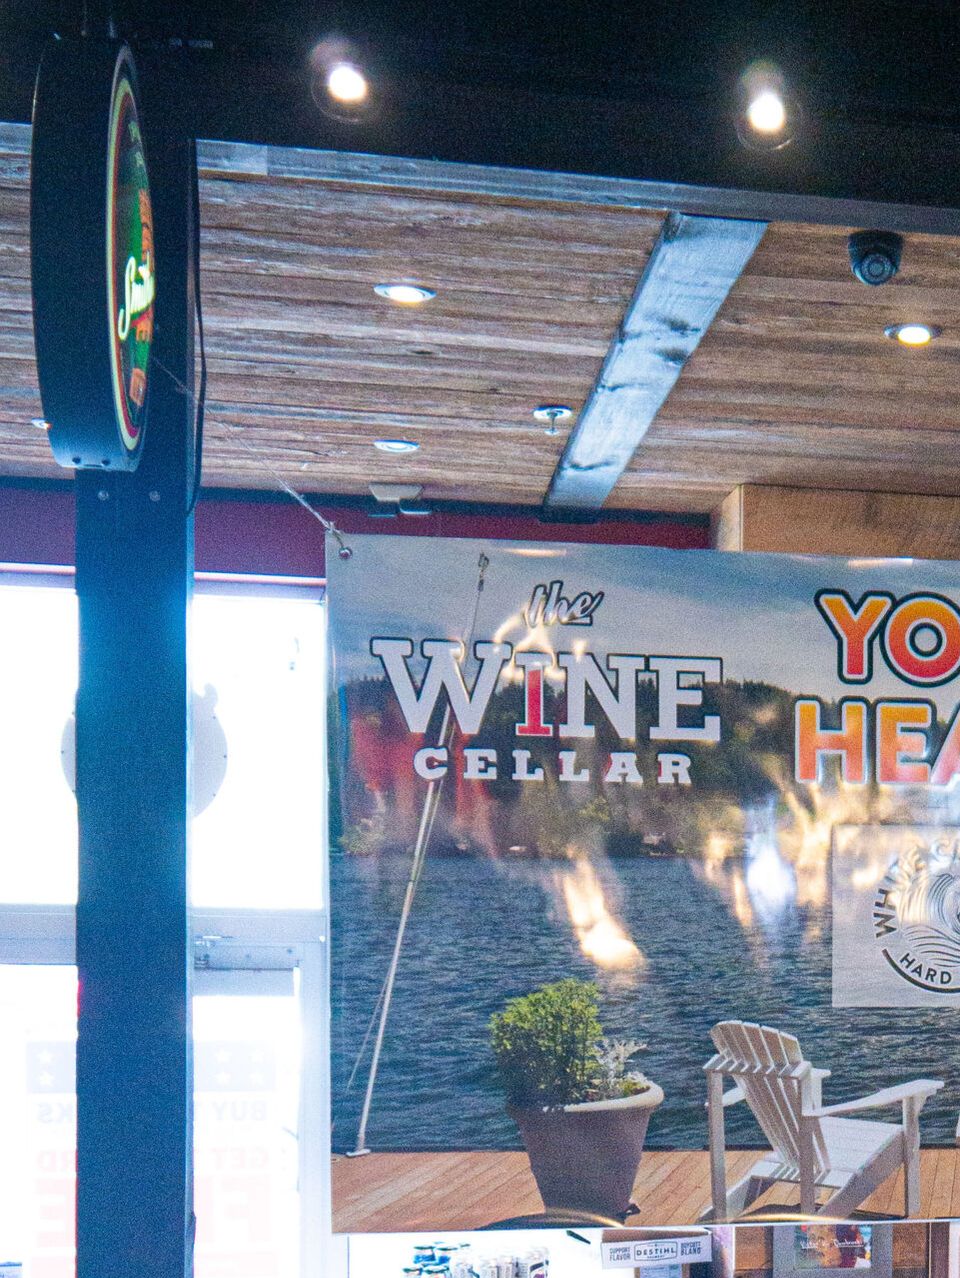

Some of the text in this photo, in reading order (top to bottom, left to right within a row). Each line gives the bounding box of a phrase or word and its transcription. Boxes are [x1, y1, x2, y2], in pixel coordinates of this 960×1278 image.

[521, 580, 604, 628] the
[370, 636, 723, 742] WINE
[413, 745, 691, 785] CELLAR
[899, 952, 952, 984] HARD
